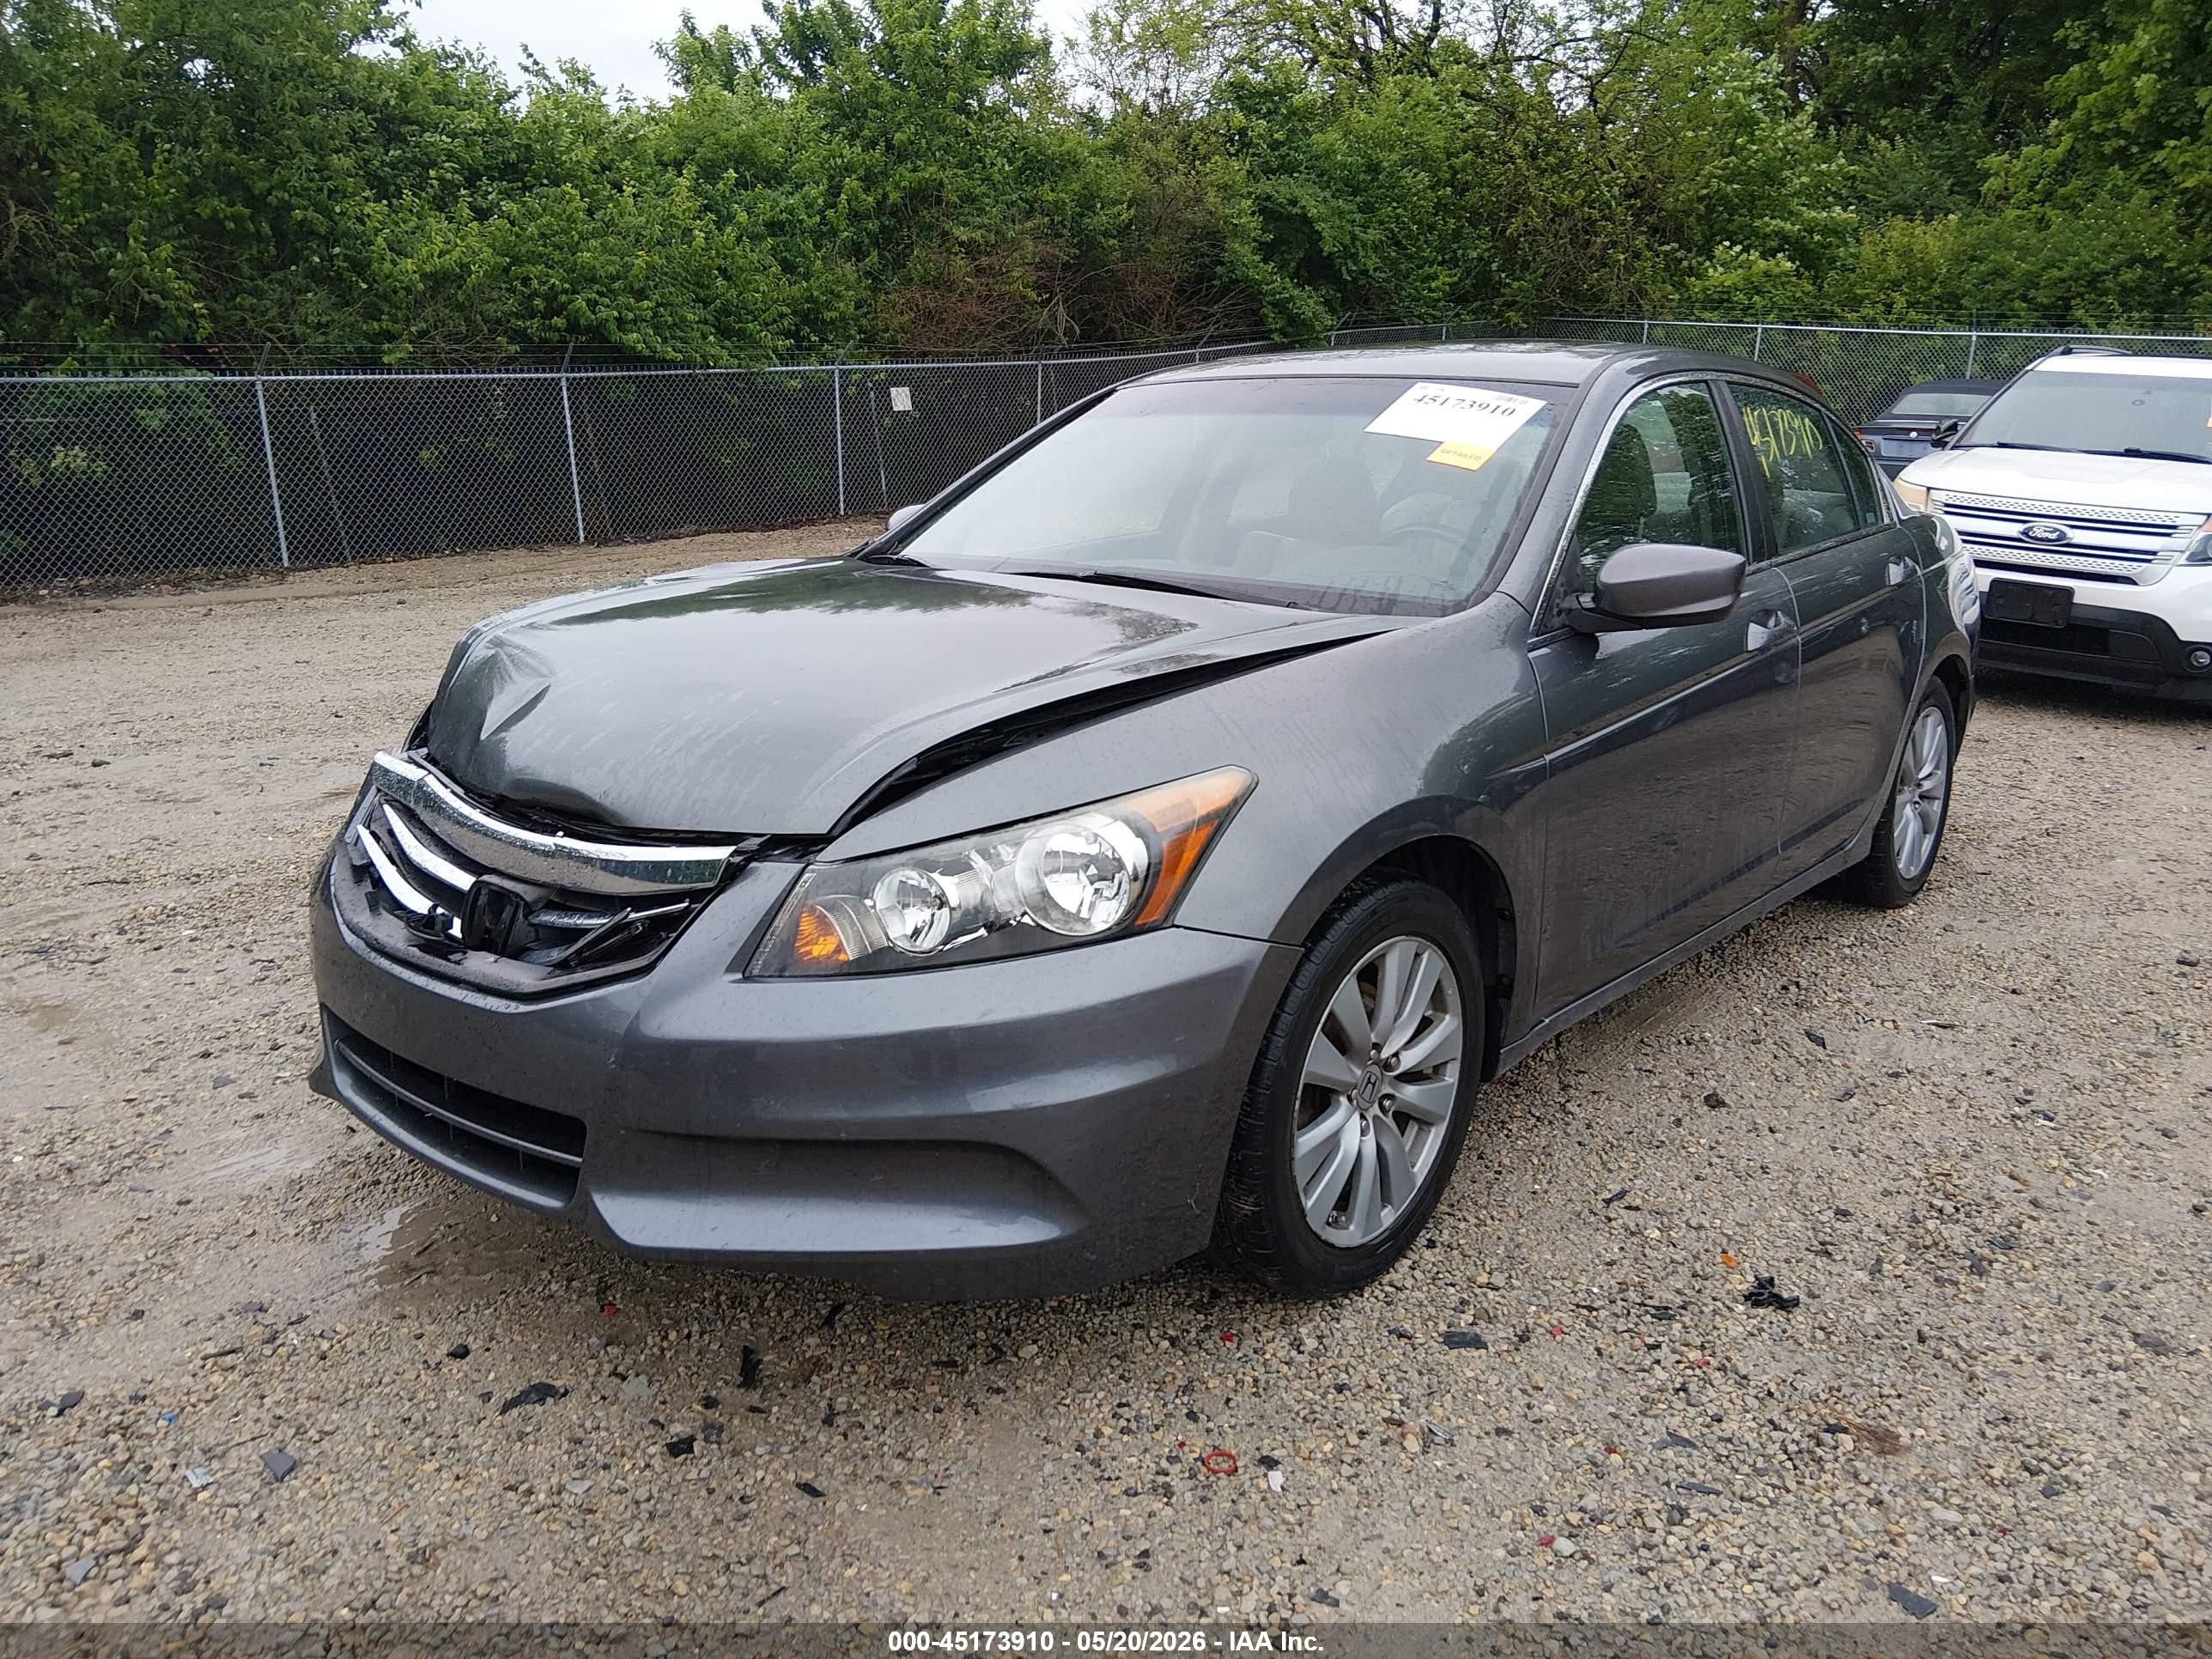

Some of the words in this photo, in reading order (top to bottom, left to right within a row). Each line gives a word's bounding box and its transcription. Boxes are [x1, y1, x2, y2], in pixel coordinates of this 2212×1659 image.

[1413, 394, 1516, 416] 45173910
[1440, 448, 1482, 461] DETAILED
[2028, 526, 2061, 539] Ford
